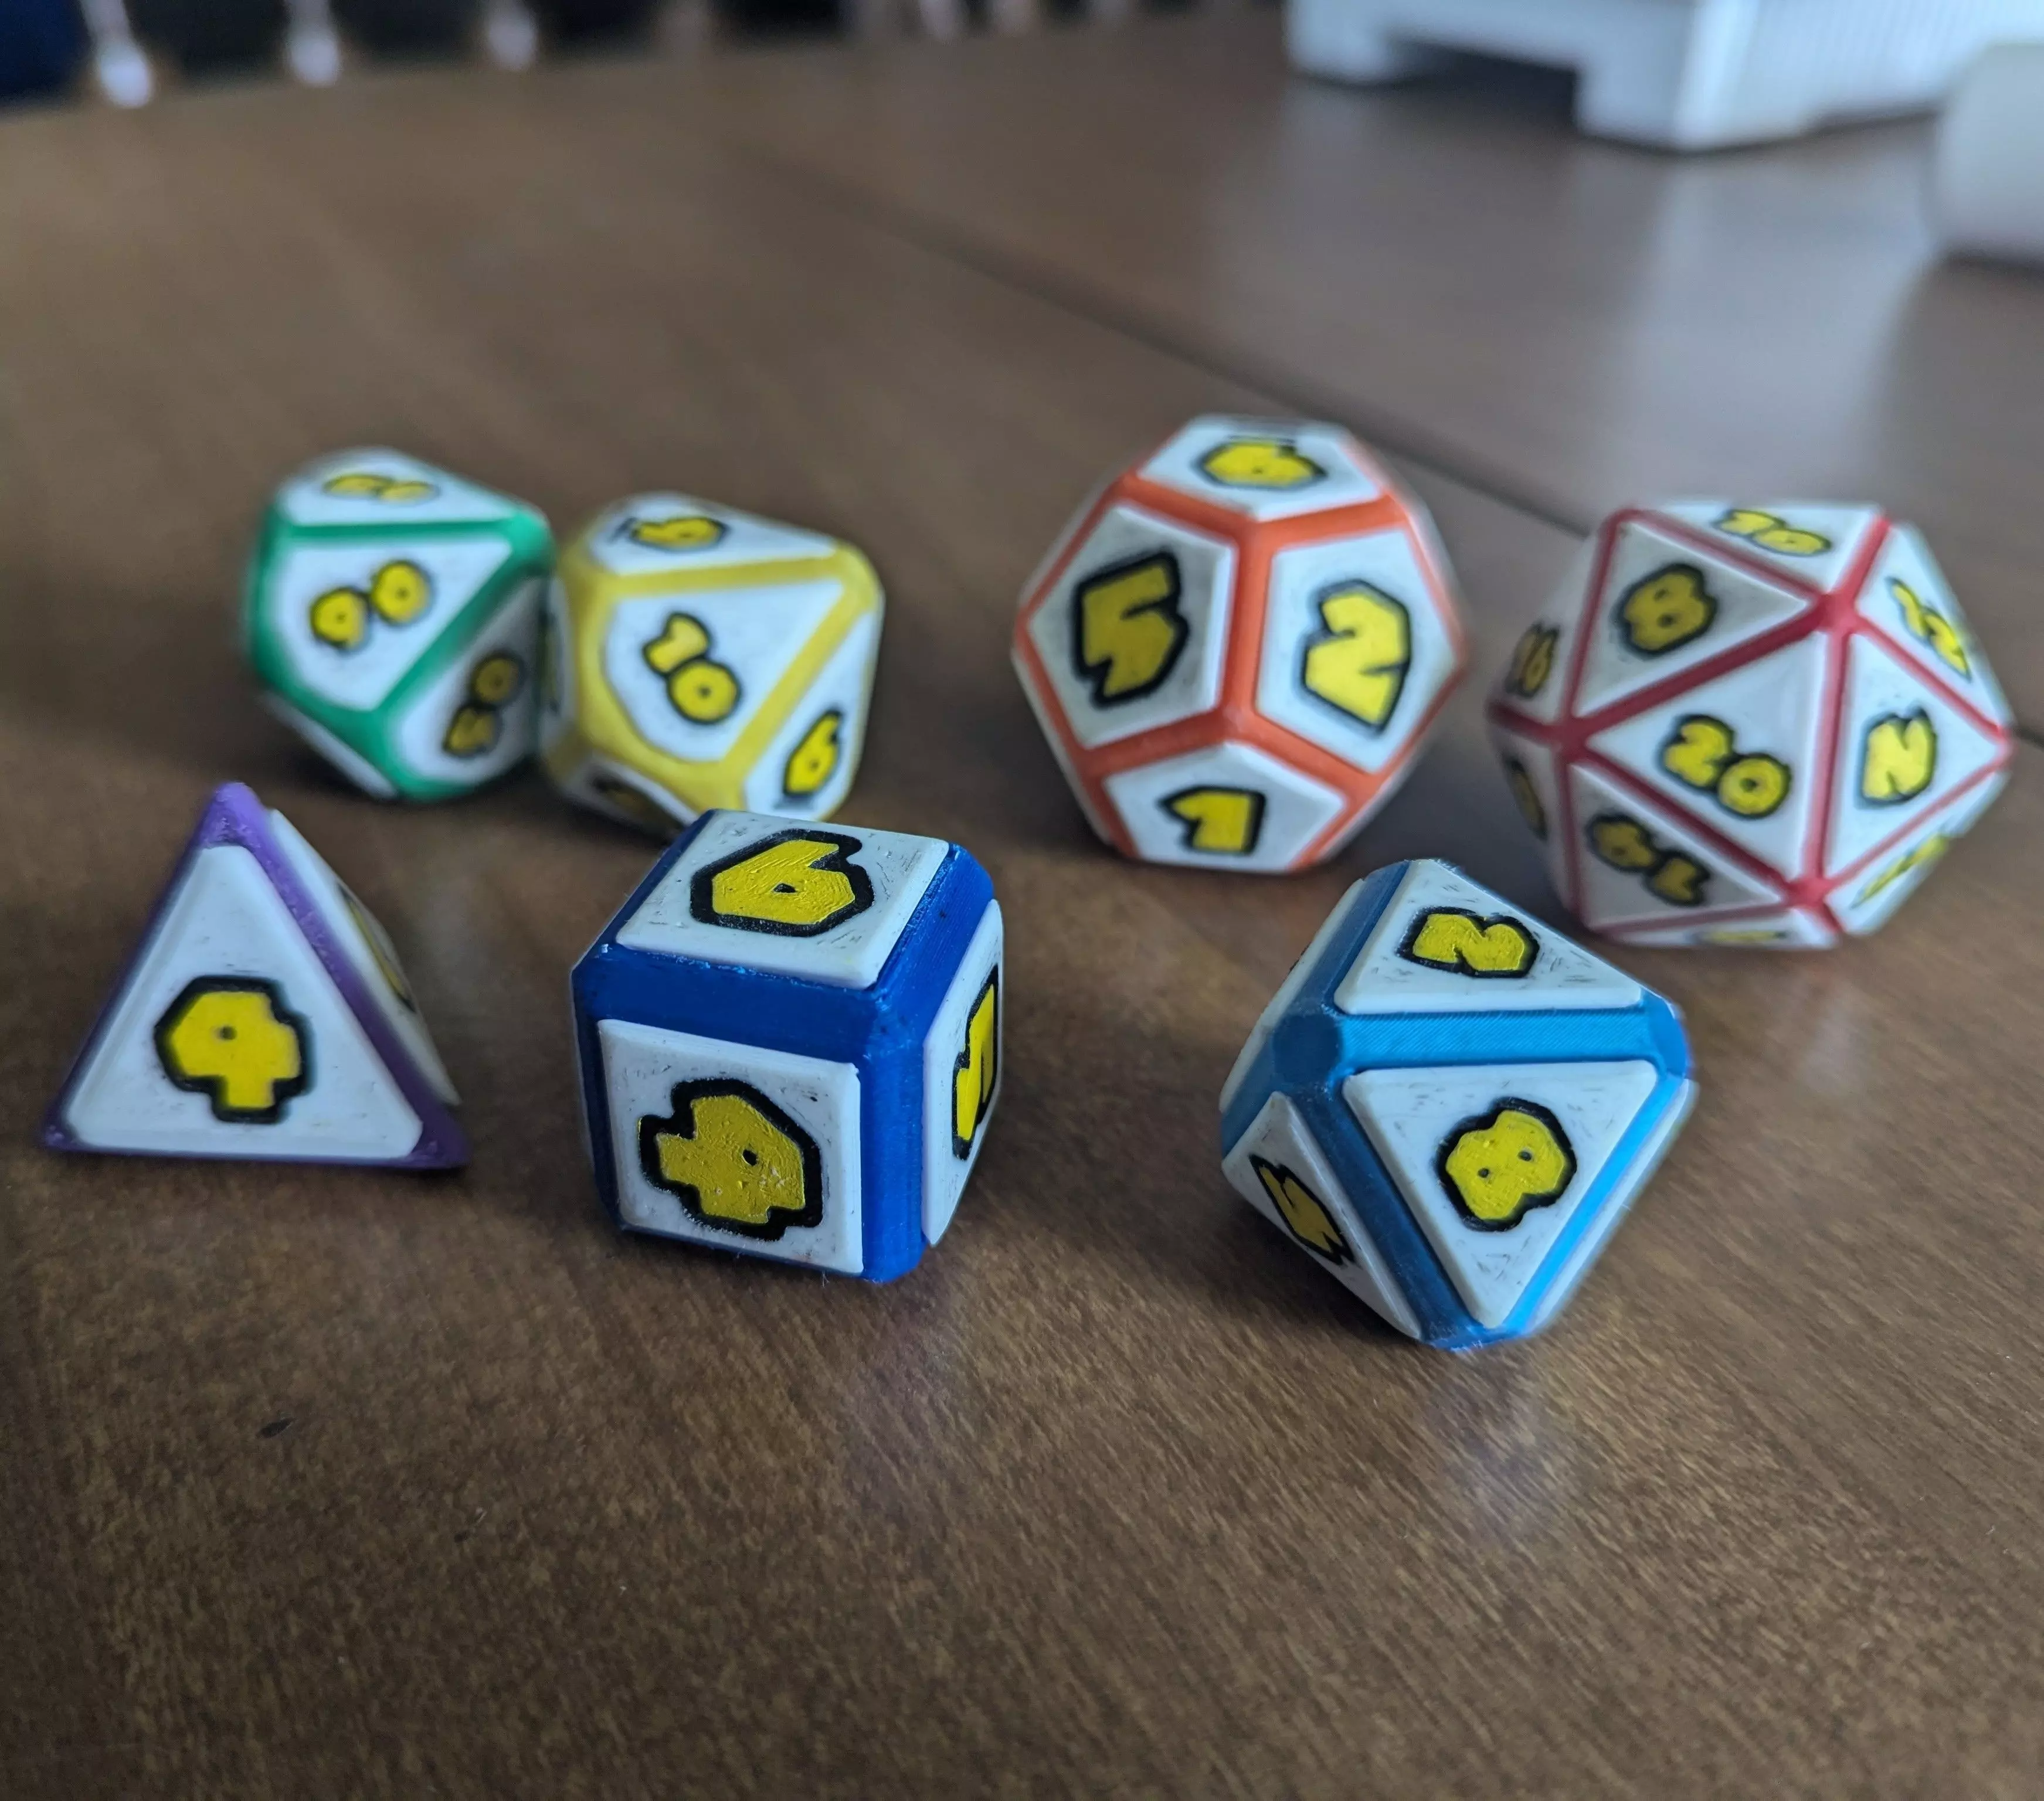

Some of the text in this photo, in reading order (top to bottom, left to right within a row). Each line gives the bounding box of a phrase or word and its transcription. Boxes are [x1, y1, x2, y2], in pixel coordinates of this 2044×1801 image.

[1070, 550, 1189, 708] 5
[1300, 579, 1412, 736] 2
[1615, 561, 1718, 658] 8
[641, 611, 742, 725] 10
[1659, 713, 1791, 820] 20
[1856, 706, 1937, 806] 2
[1156, 786, 1265, 855] 1
[691, 829, 874, 937] 6
[154, 975, 315, 1124] 4
[638, 1078, 823, 1242] 4
[1434, 1097, 1577, 1233] 8
